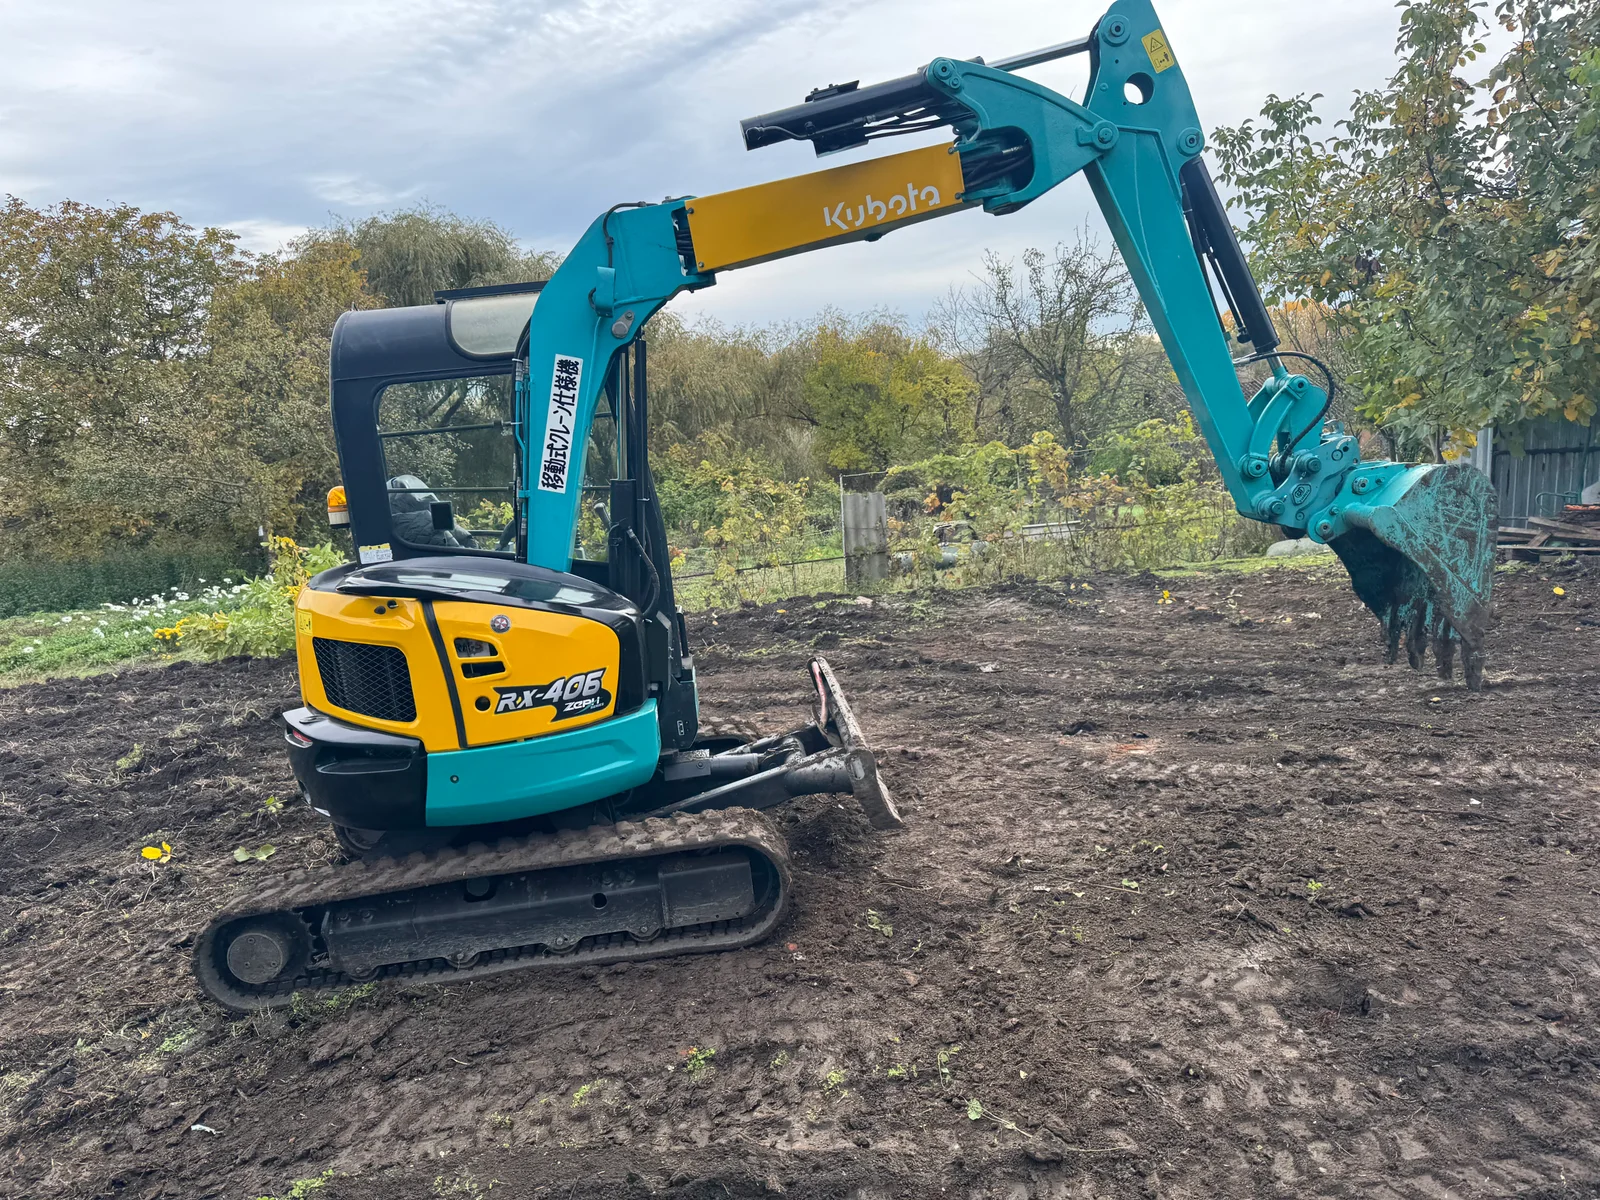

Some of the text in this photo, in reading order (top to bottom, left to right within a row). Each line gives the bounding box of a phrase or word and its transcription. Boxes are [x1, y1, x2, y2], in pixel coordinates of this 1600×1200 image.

[823, 182, 940, 231] Kubota
[540, 358, 580, 490] 移動式クレーン仕様機
[496, 670, 604, 713] RX-406
